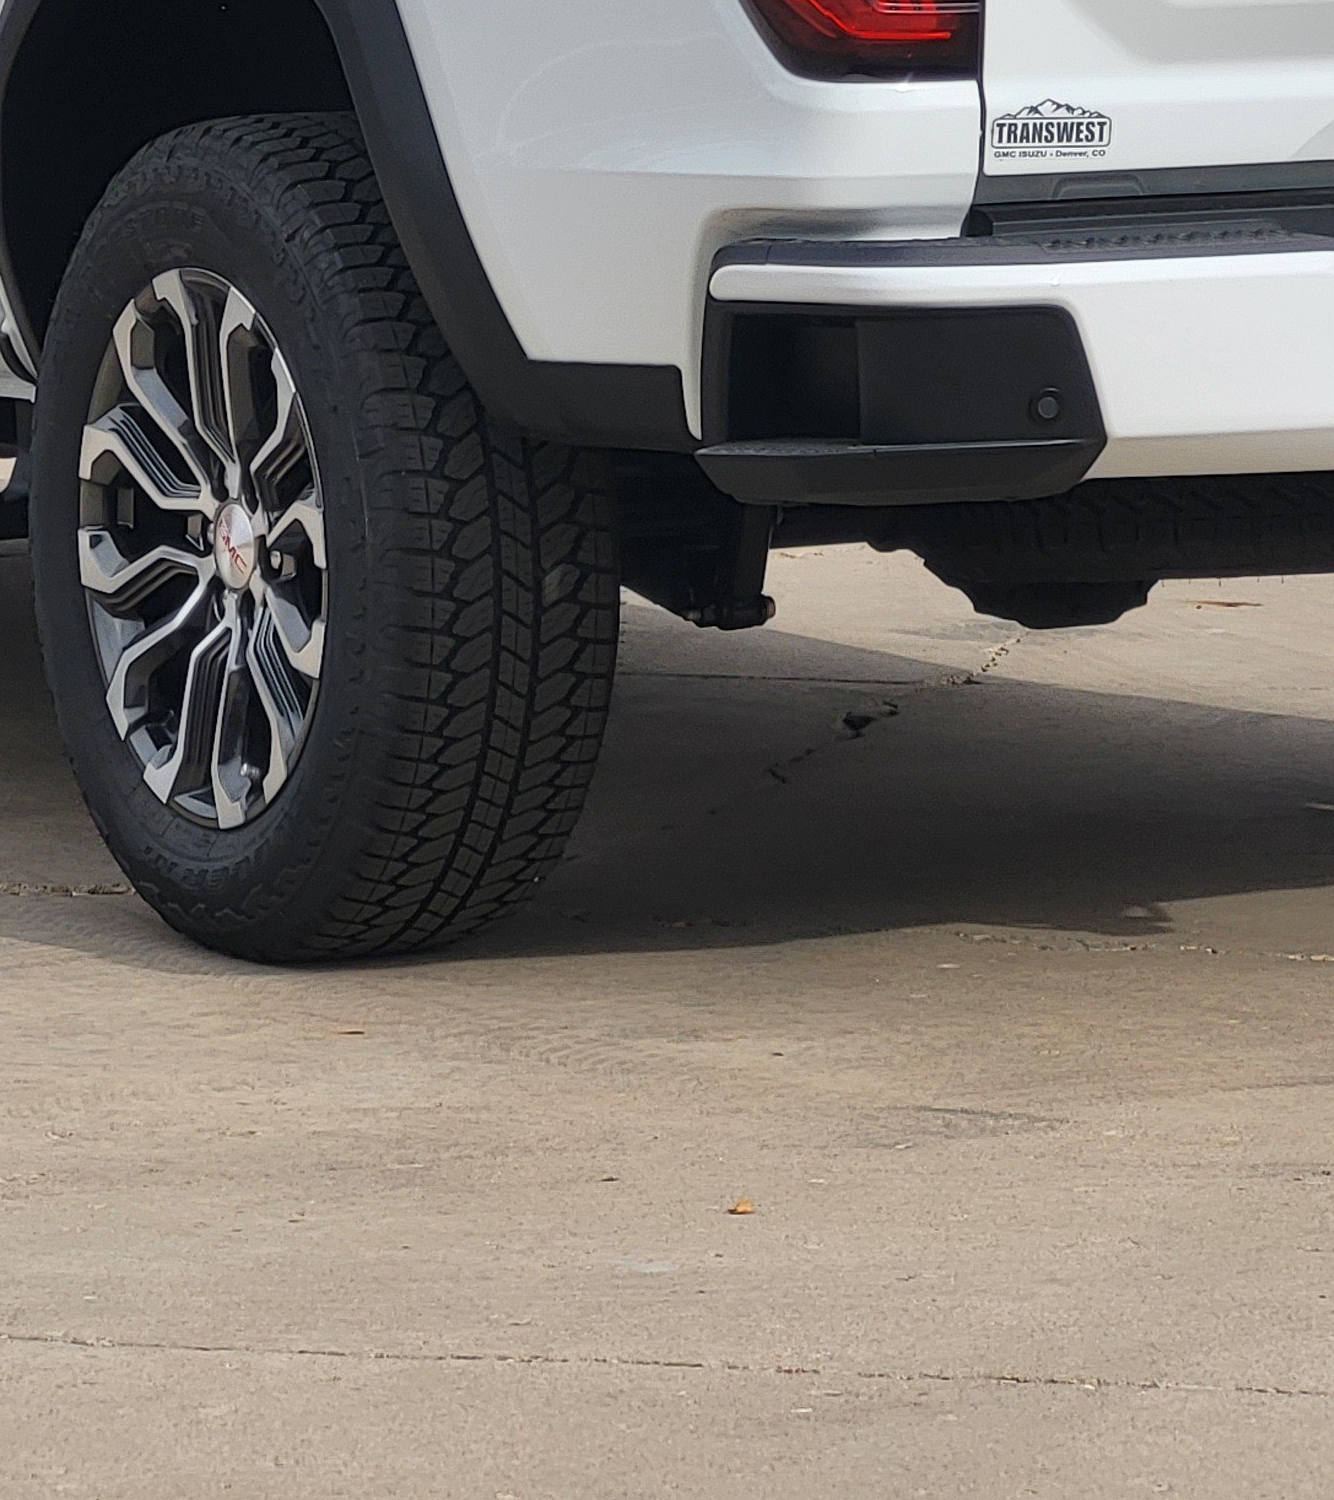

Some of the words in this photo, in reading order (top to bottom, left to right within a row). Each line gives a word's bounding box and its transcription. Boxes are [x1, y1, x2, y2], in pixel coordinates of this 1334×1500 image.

[996, 121, 1107, 144] TRANSWEST
[994, 150, 1016, 158] GMC
[1018, 150, 1047, 158] ISUZU
